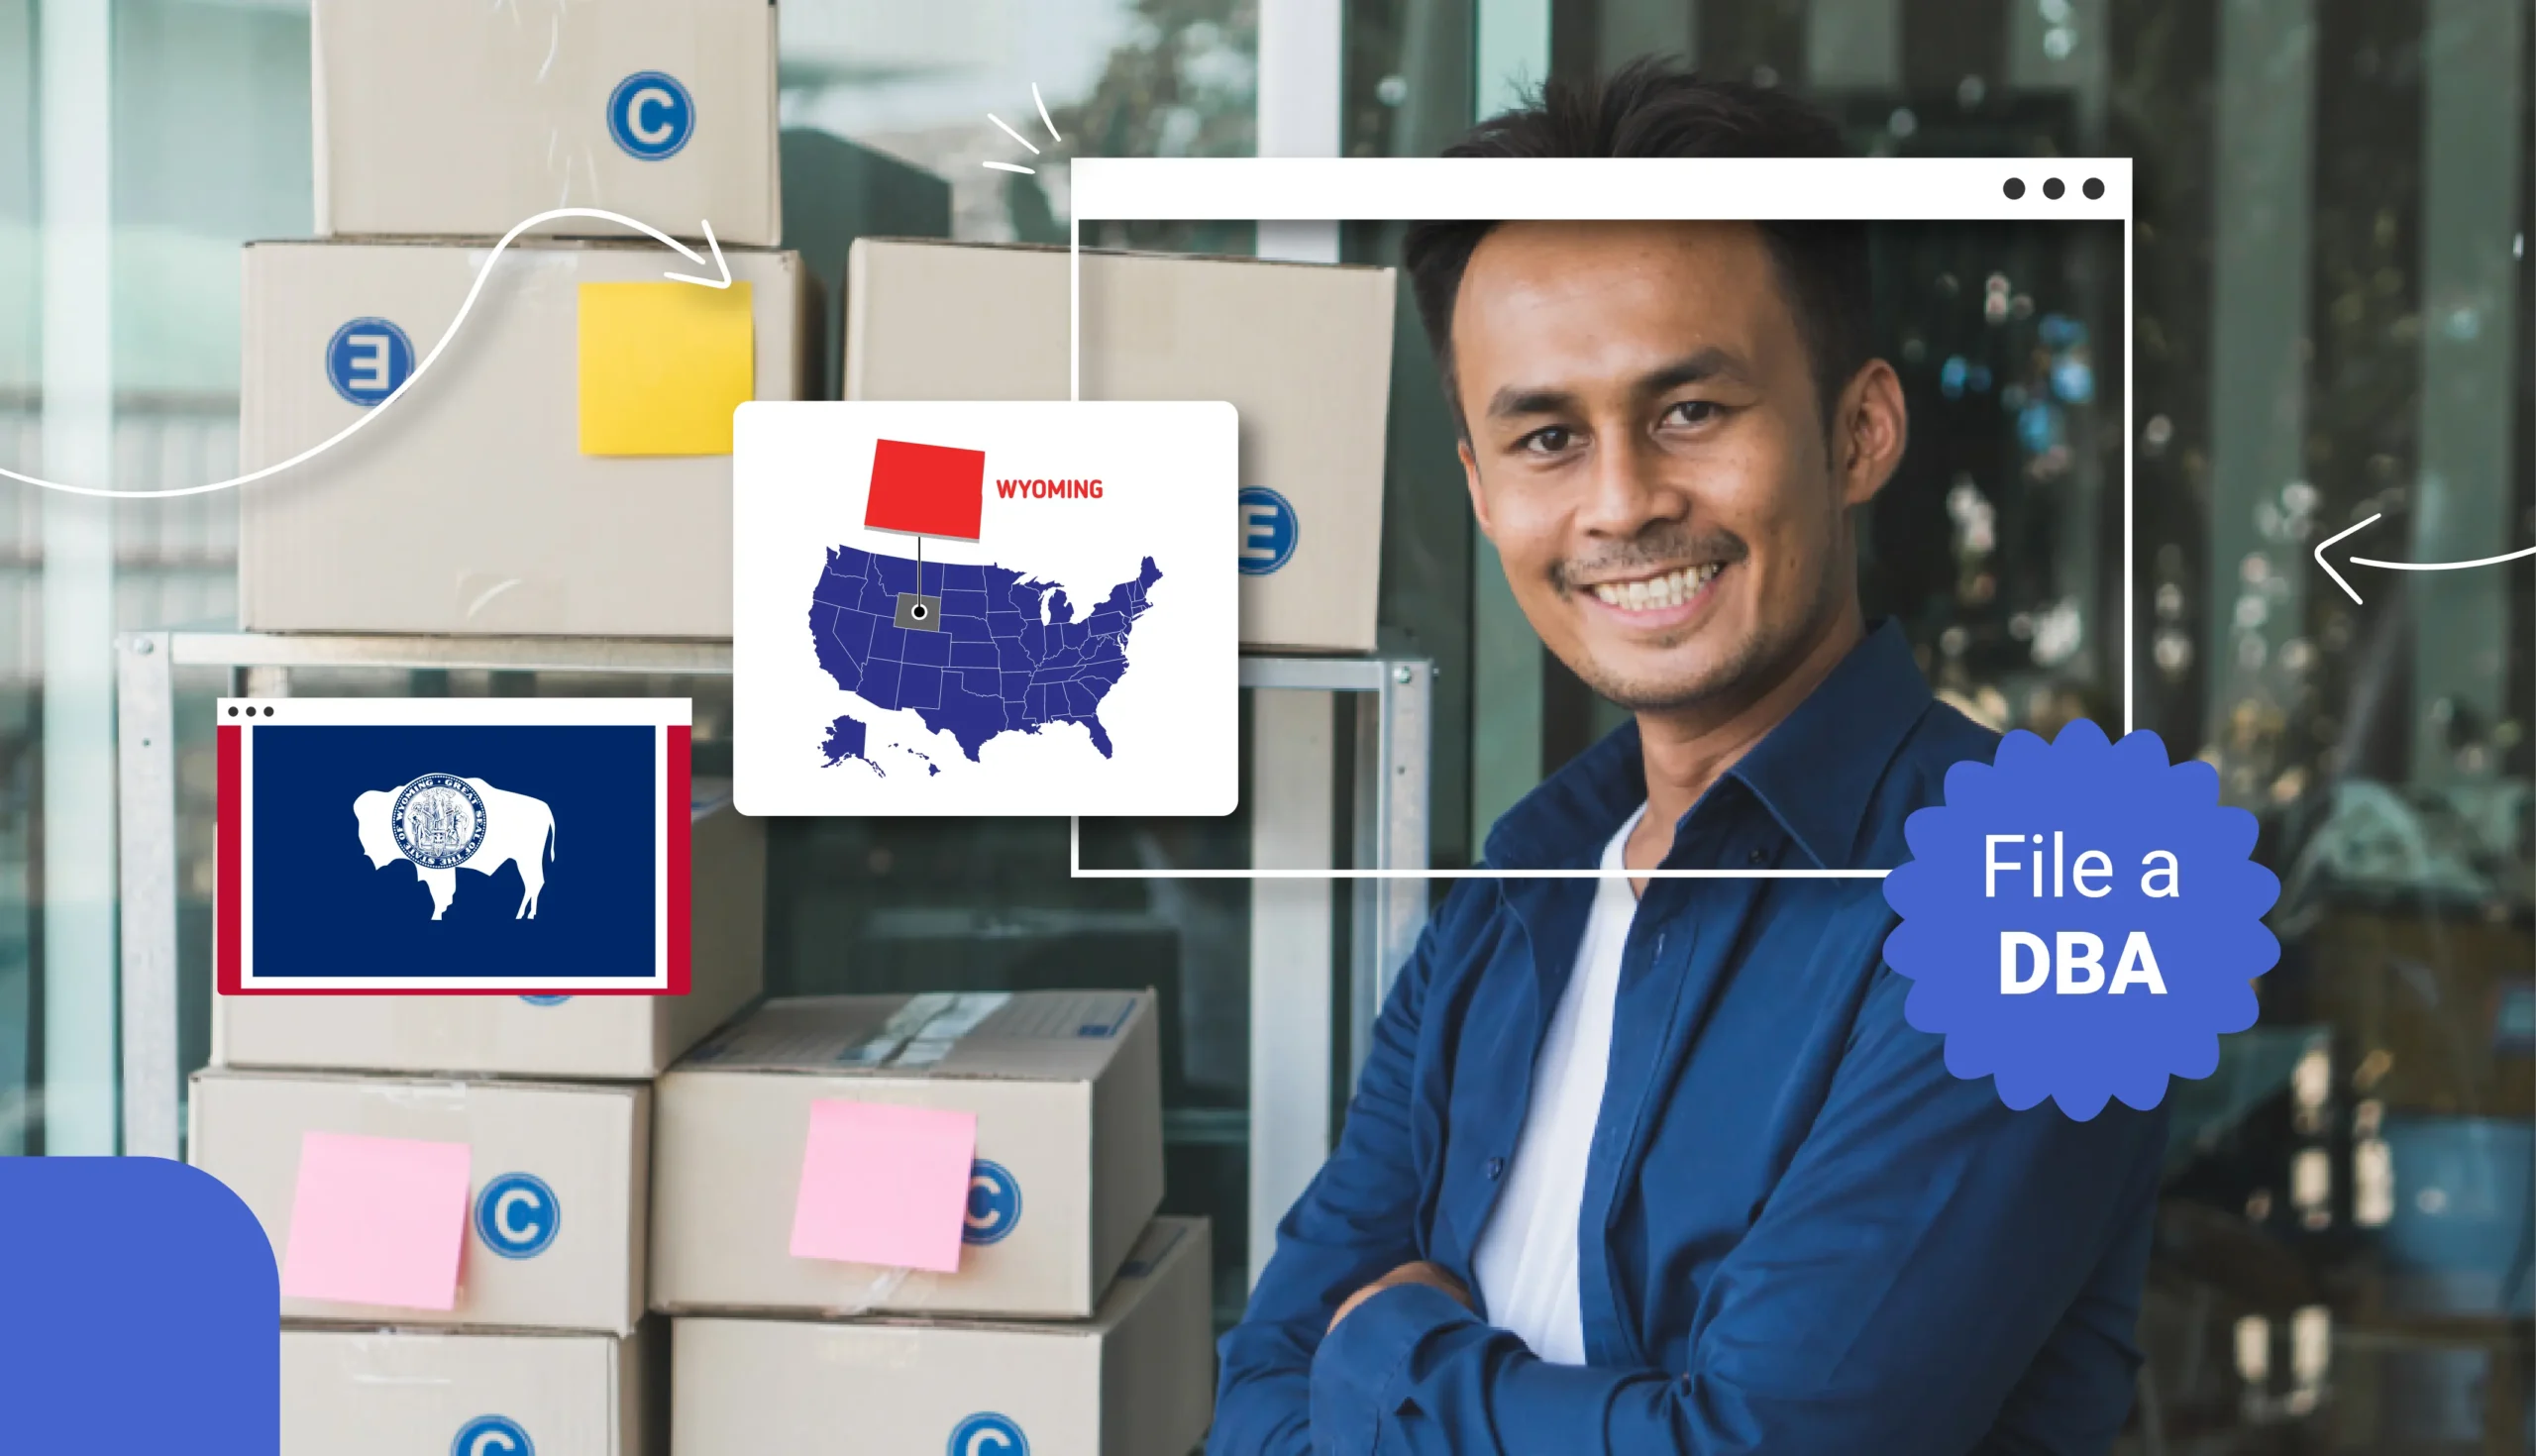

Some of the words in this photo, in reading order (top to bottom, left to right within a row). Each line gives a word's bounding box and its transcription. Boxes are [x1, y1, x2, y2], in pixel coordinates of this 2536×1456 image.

[628, 87, 674, 144] C
[1238, 504, 1277, 559] E
[496, 1189, 540, 1243] C
